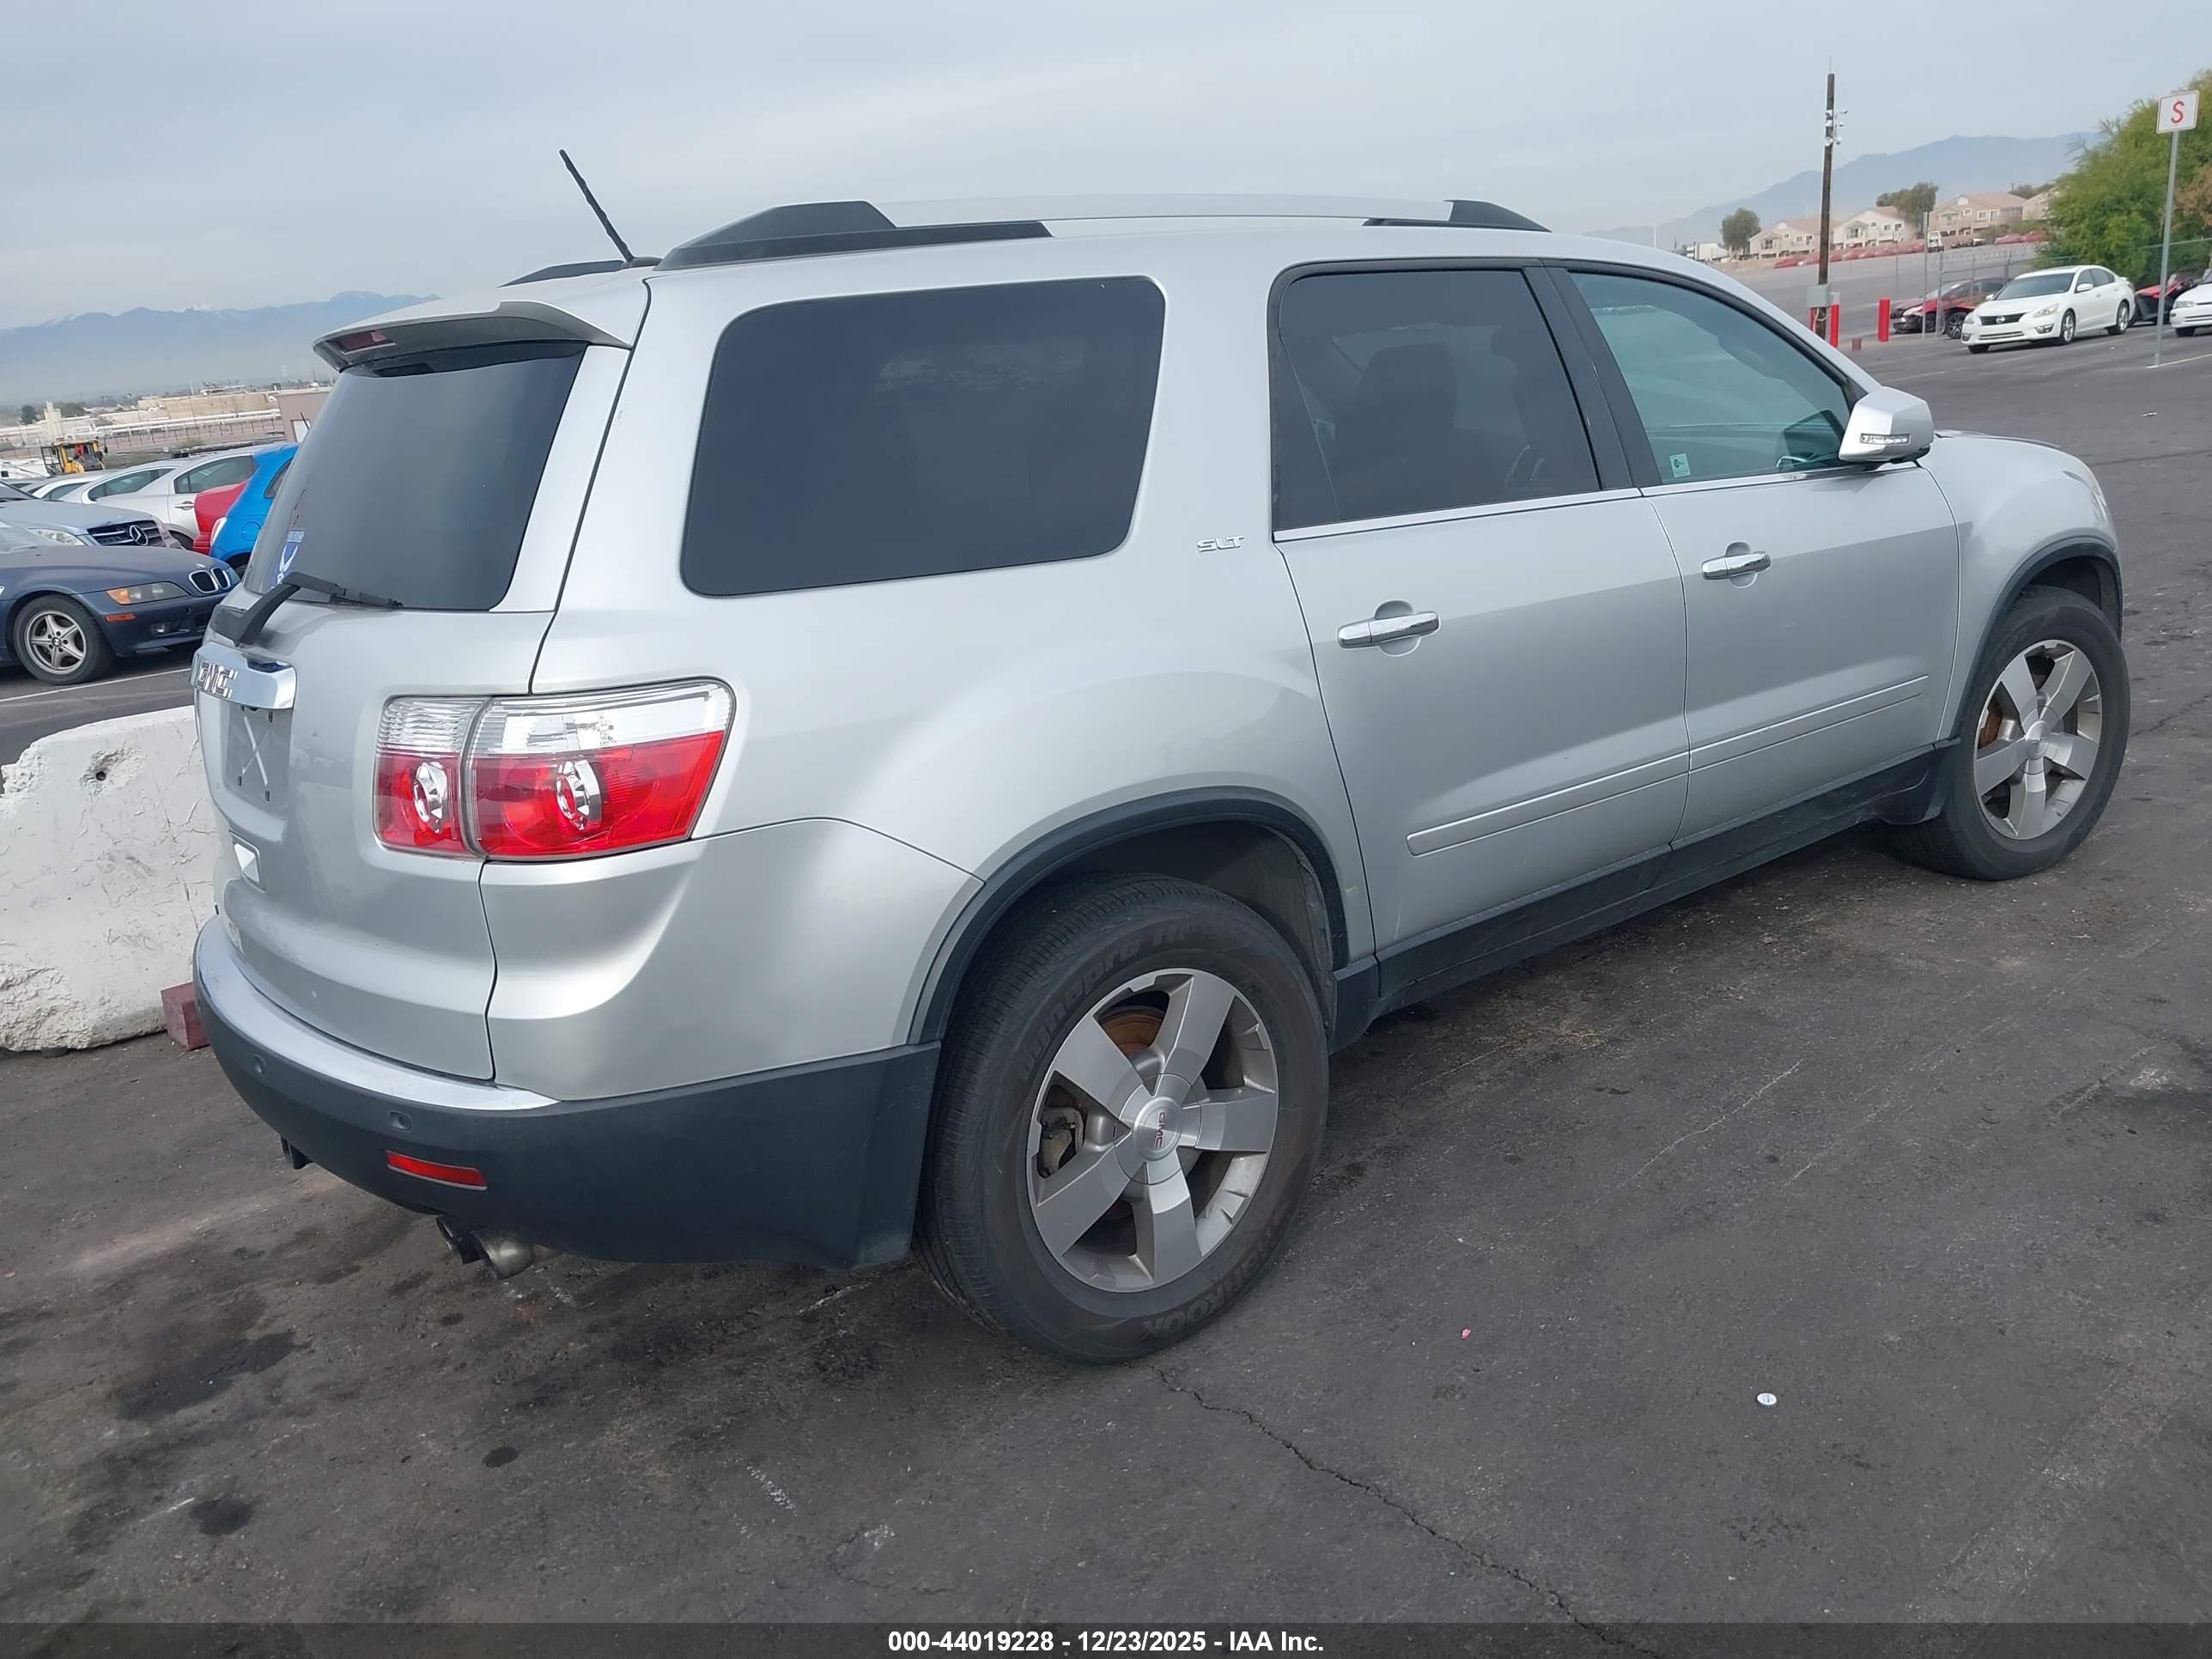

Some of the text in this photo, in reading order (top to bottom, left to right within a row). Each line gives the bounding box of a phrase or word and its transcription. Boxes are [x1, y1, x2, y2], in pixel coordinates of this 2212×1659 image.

[2171, 100, 2185, 124] S
[1196, 536, 1245, 552] SLT
[197, 661, 237, 699] GMC
[1154, 1111, 1166, 1149] GMC
